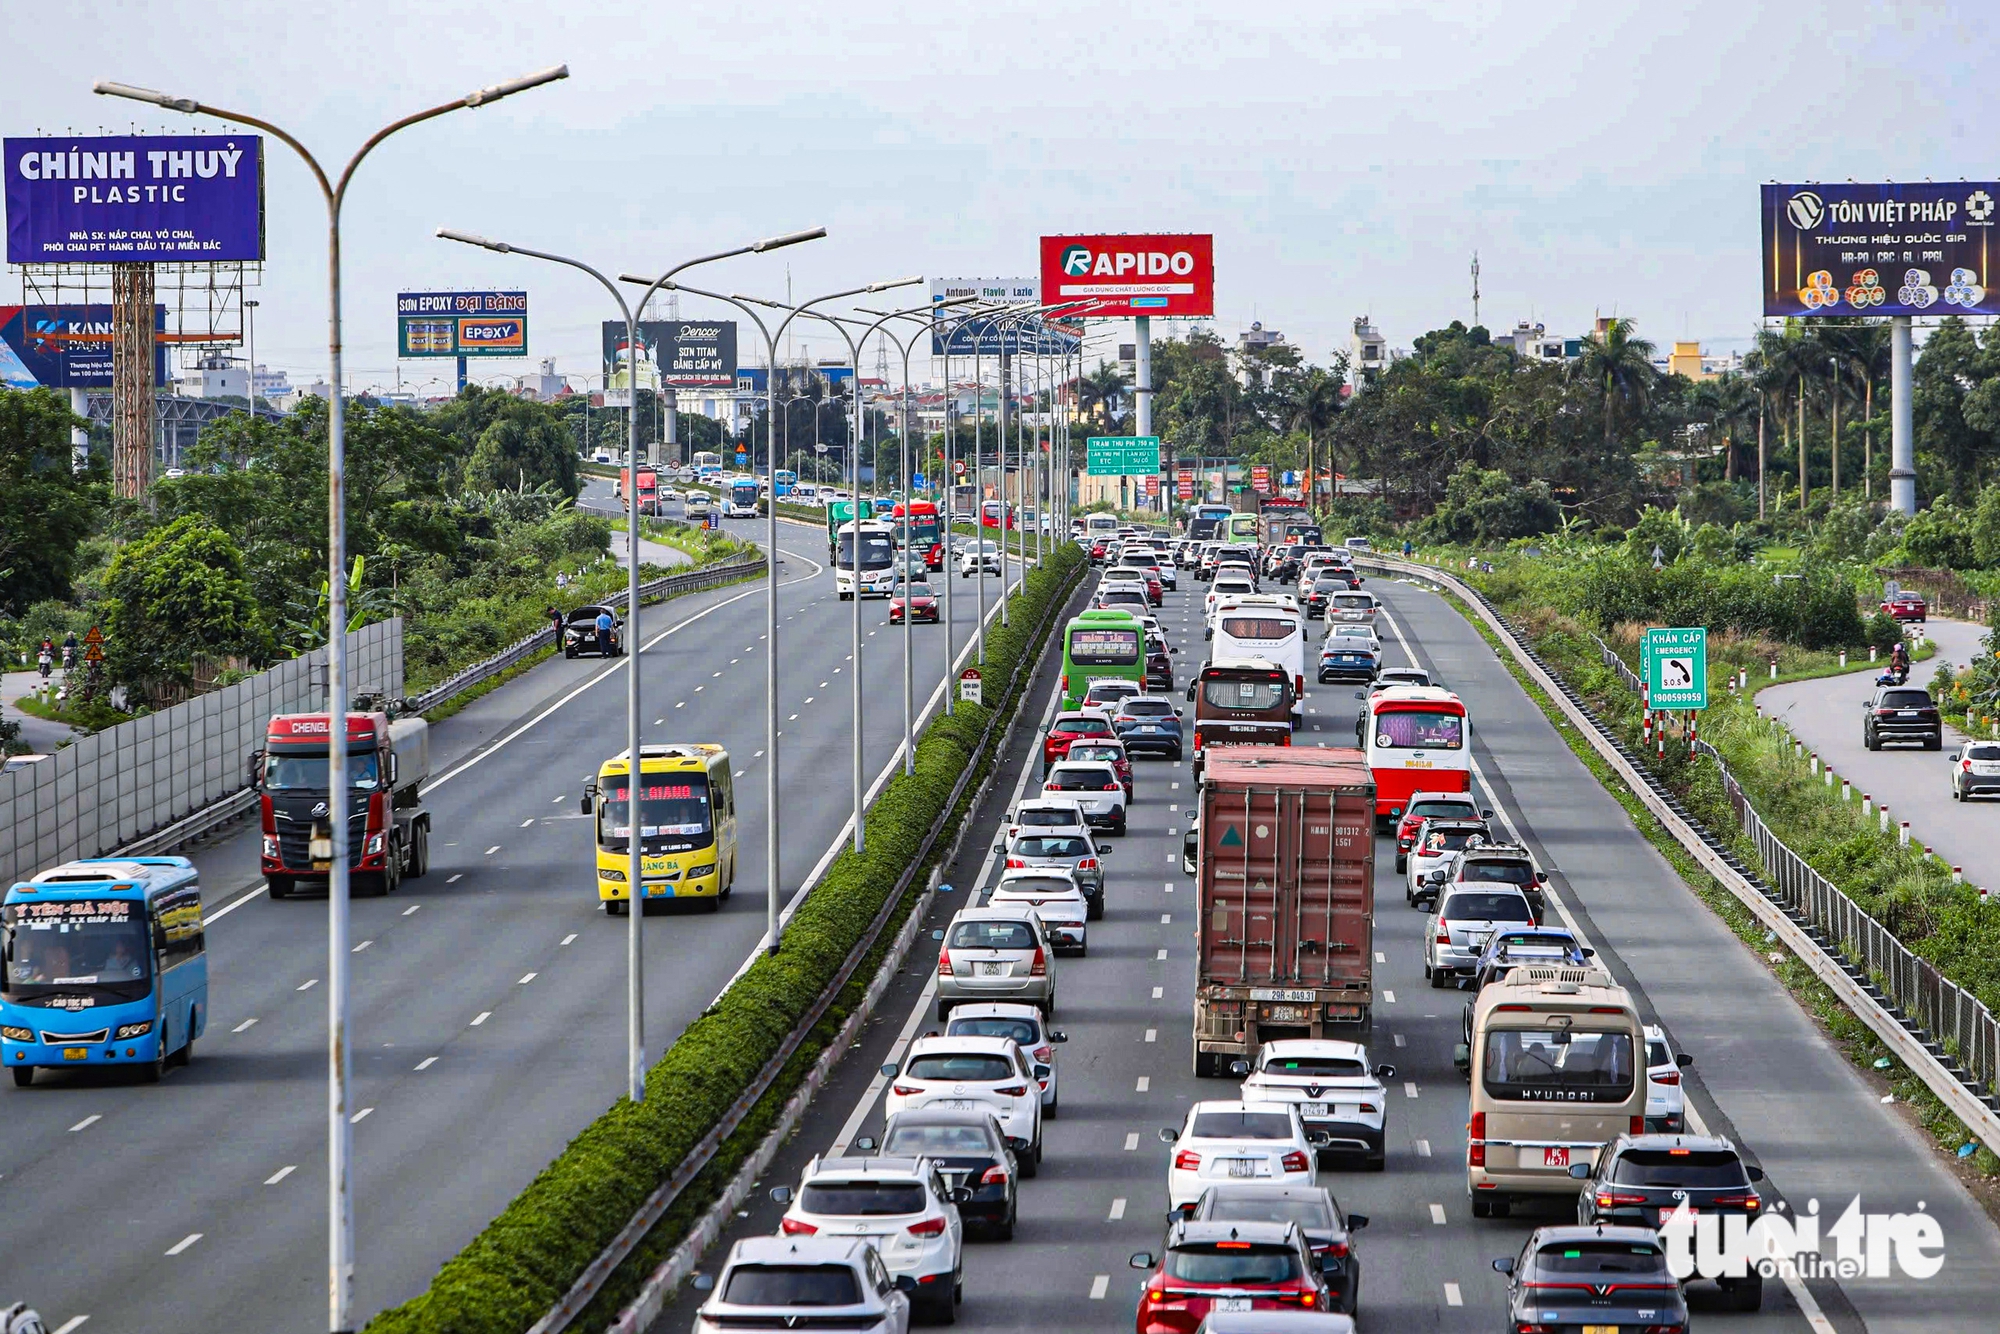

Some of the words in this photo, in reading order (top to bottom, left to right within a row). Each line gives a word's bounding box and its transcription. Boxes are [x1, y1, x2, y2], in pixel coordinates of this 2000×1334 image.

[20, 145, 135, 180] CHÍNH
[148, 142, 243, 178] THUỶ
[74, 185, 185, 203] PLASTIC
[1829, 200, 1864, 223] TÔN
[1867, 199, 1905, 227] VIỆT
[1910, 198, 1957, 222] PHÁP
[69, 230, 88, 240] NHÀ
[91, 231, 106, 240] SX:
[66, 243, 87, 251] CHAI
[90, 243, 105, 251] PET
[109, 241, 133, 251] HÀNG
[1063, 249, 1194, 276] RAPIDO
[1877, 251, 1895, 263] CRC
[1903, 251, 1914, 263] GL
[1922, 251, 1944, 262] PPGL
[399, 299, 417, 312] SƠN
[419, 296, 452, 311] EPOXY
[455, 296, 481, 313] ĐẠI
[485, 293, 526, 311] BÀNG
[466, 325, 511, 339] EPOXY
[674, 325, 721, 343] Pencco
[679, 347, 695, 357] SƠN
[697, 347, 717, 357] TITAN
[1652, 630, 1678, 644] KHẨN
[1682, 630, 1701, 643] CẤP
[1655, 646, 1698, 655] EMERGENCY
[1653, 692, 1702, 702] 1900599959
[291, 721, 348, 733] CHENGL
[1335, 826, 1359, 836] 901312
[1365, 828, 1370, 837] 2
[1272, 991, 1285, 1000] 29R
[1522, 1089, 1594, 1101] HYUNDAI
[1552, 1148, 1562, 1157] BC
